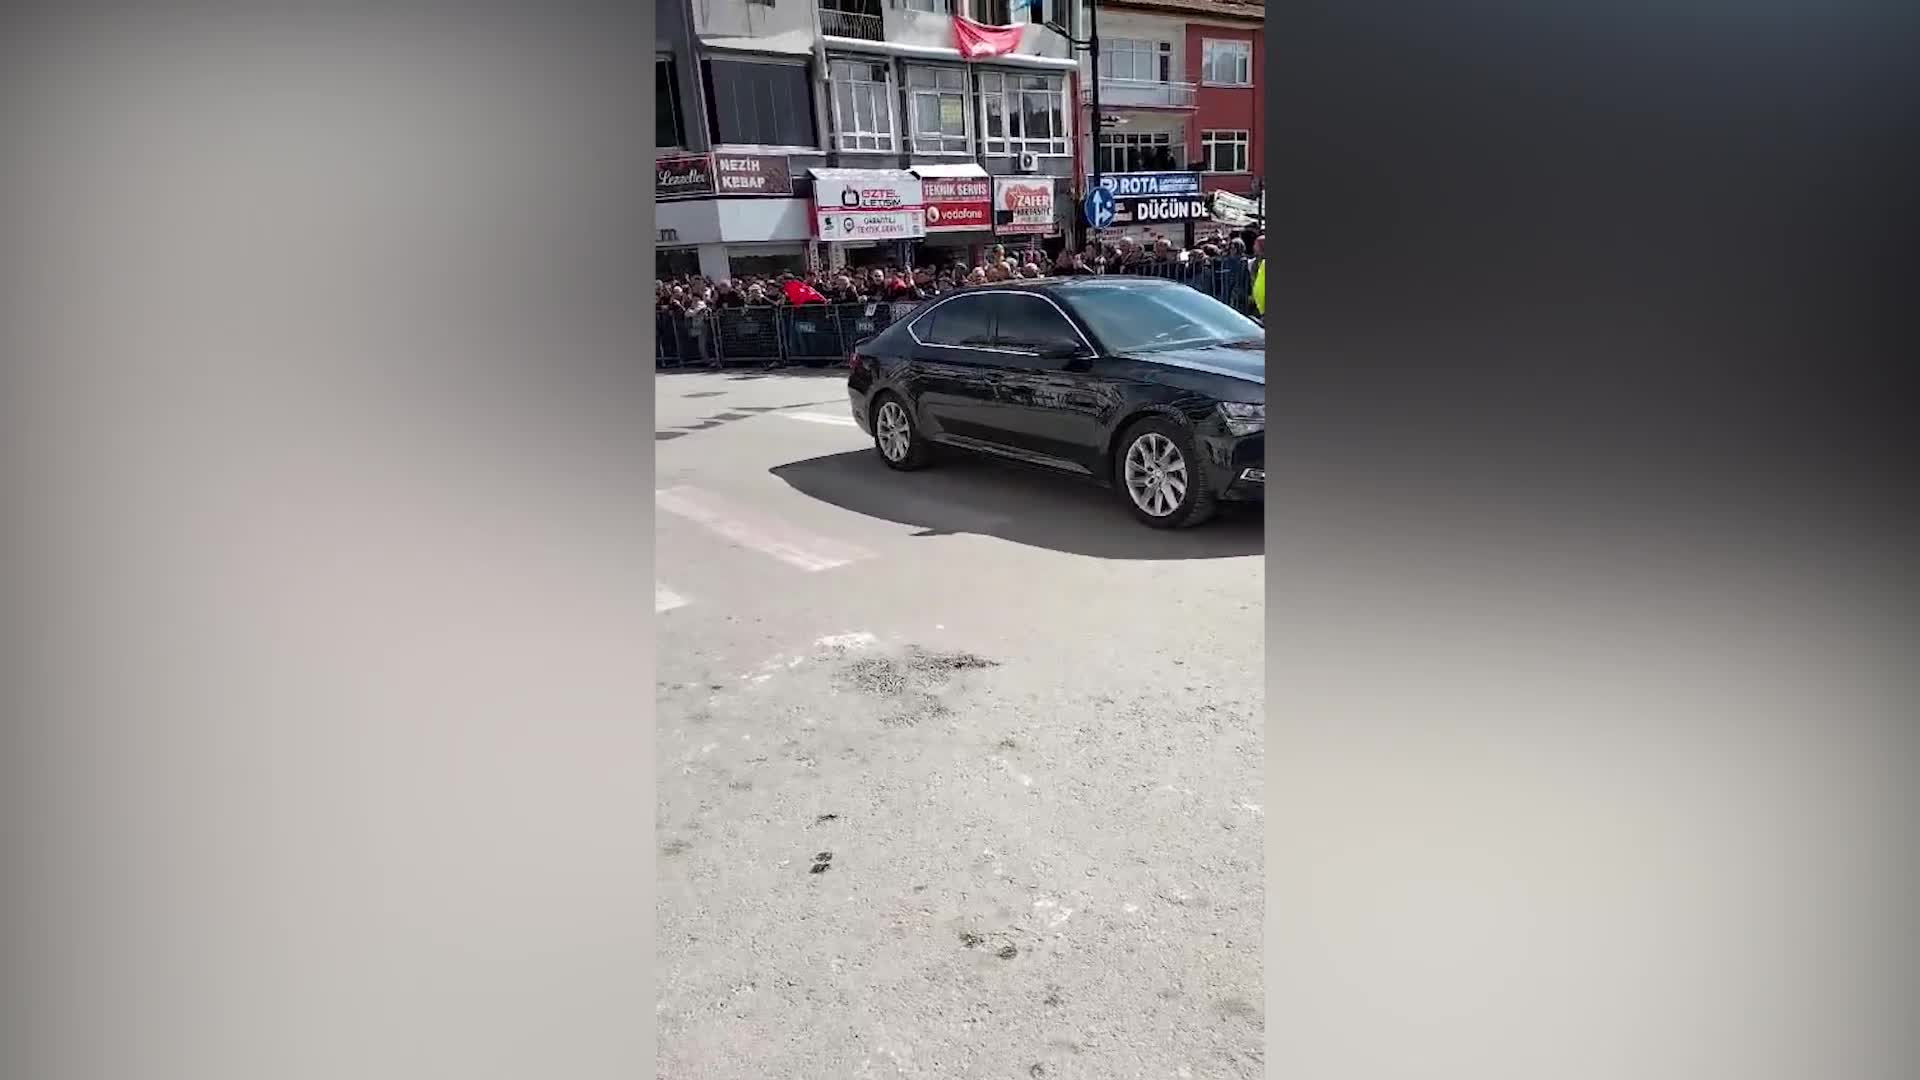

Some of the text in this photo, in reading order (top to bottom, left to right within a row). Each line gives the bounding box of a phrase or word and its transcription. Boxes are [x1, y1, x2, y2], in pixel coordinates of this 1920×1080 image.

[720, 157, 760, 171] NEZİH
[722, 176, 765, 188] KEBAP
[1119, 178, 1158, 193] ROTA
[1017, 195, 1049, 207] ZAFER
[941, 207, 983, 219] vodafone
[1138, 199, 1189, 220] DÜĞÜN
